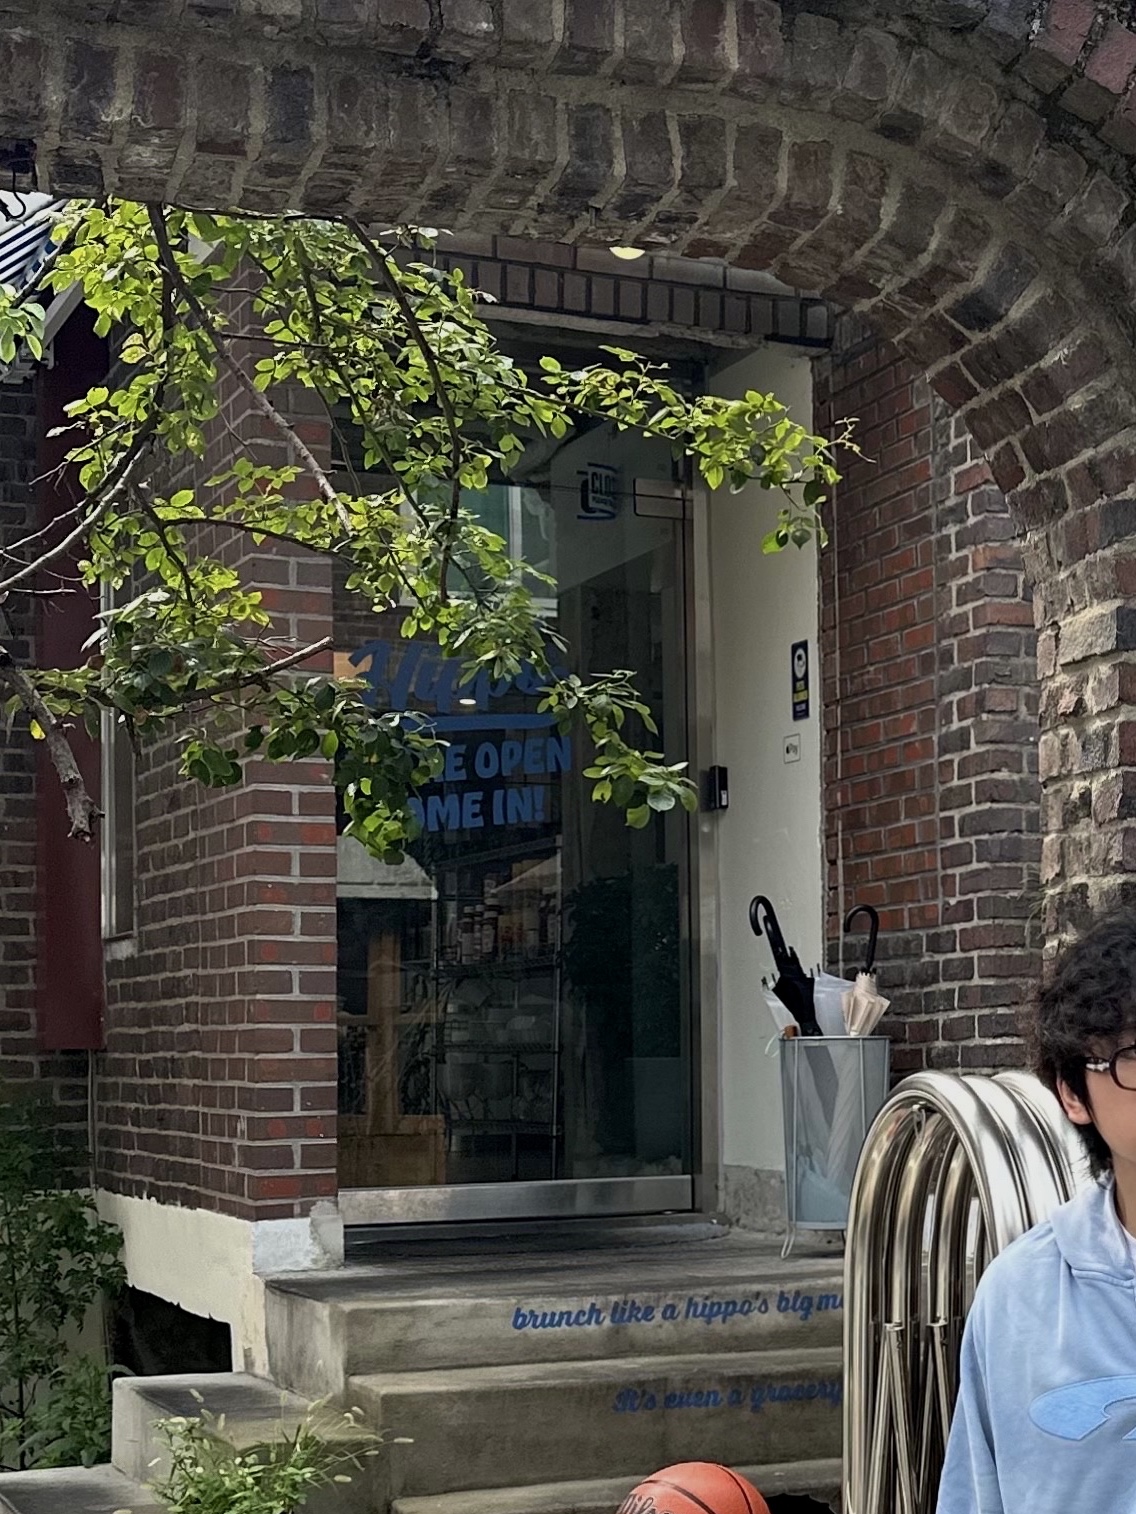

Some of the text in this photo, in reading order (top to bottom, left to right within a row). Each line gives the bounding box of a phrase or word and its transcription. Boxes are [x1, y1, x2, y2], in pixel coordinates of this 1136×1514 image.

[474, 736, 572, 779] OPEN
[492, 786, 545, 825] IN!
[512, 1302, 605, 1330] brunch
[610, 1301, 655, 1324] like
[661, 1304, 680, 1321] a
[684, 1291, 769, 1325] hippo's
[777, 1290, 813, 1321] big
[664, 1390, 724, 1408] even
[729, 1388, 745, 1407] a
